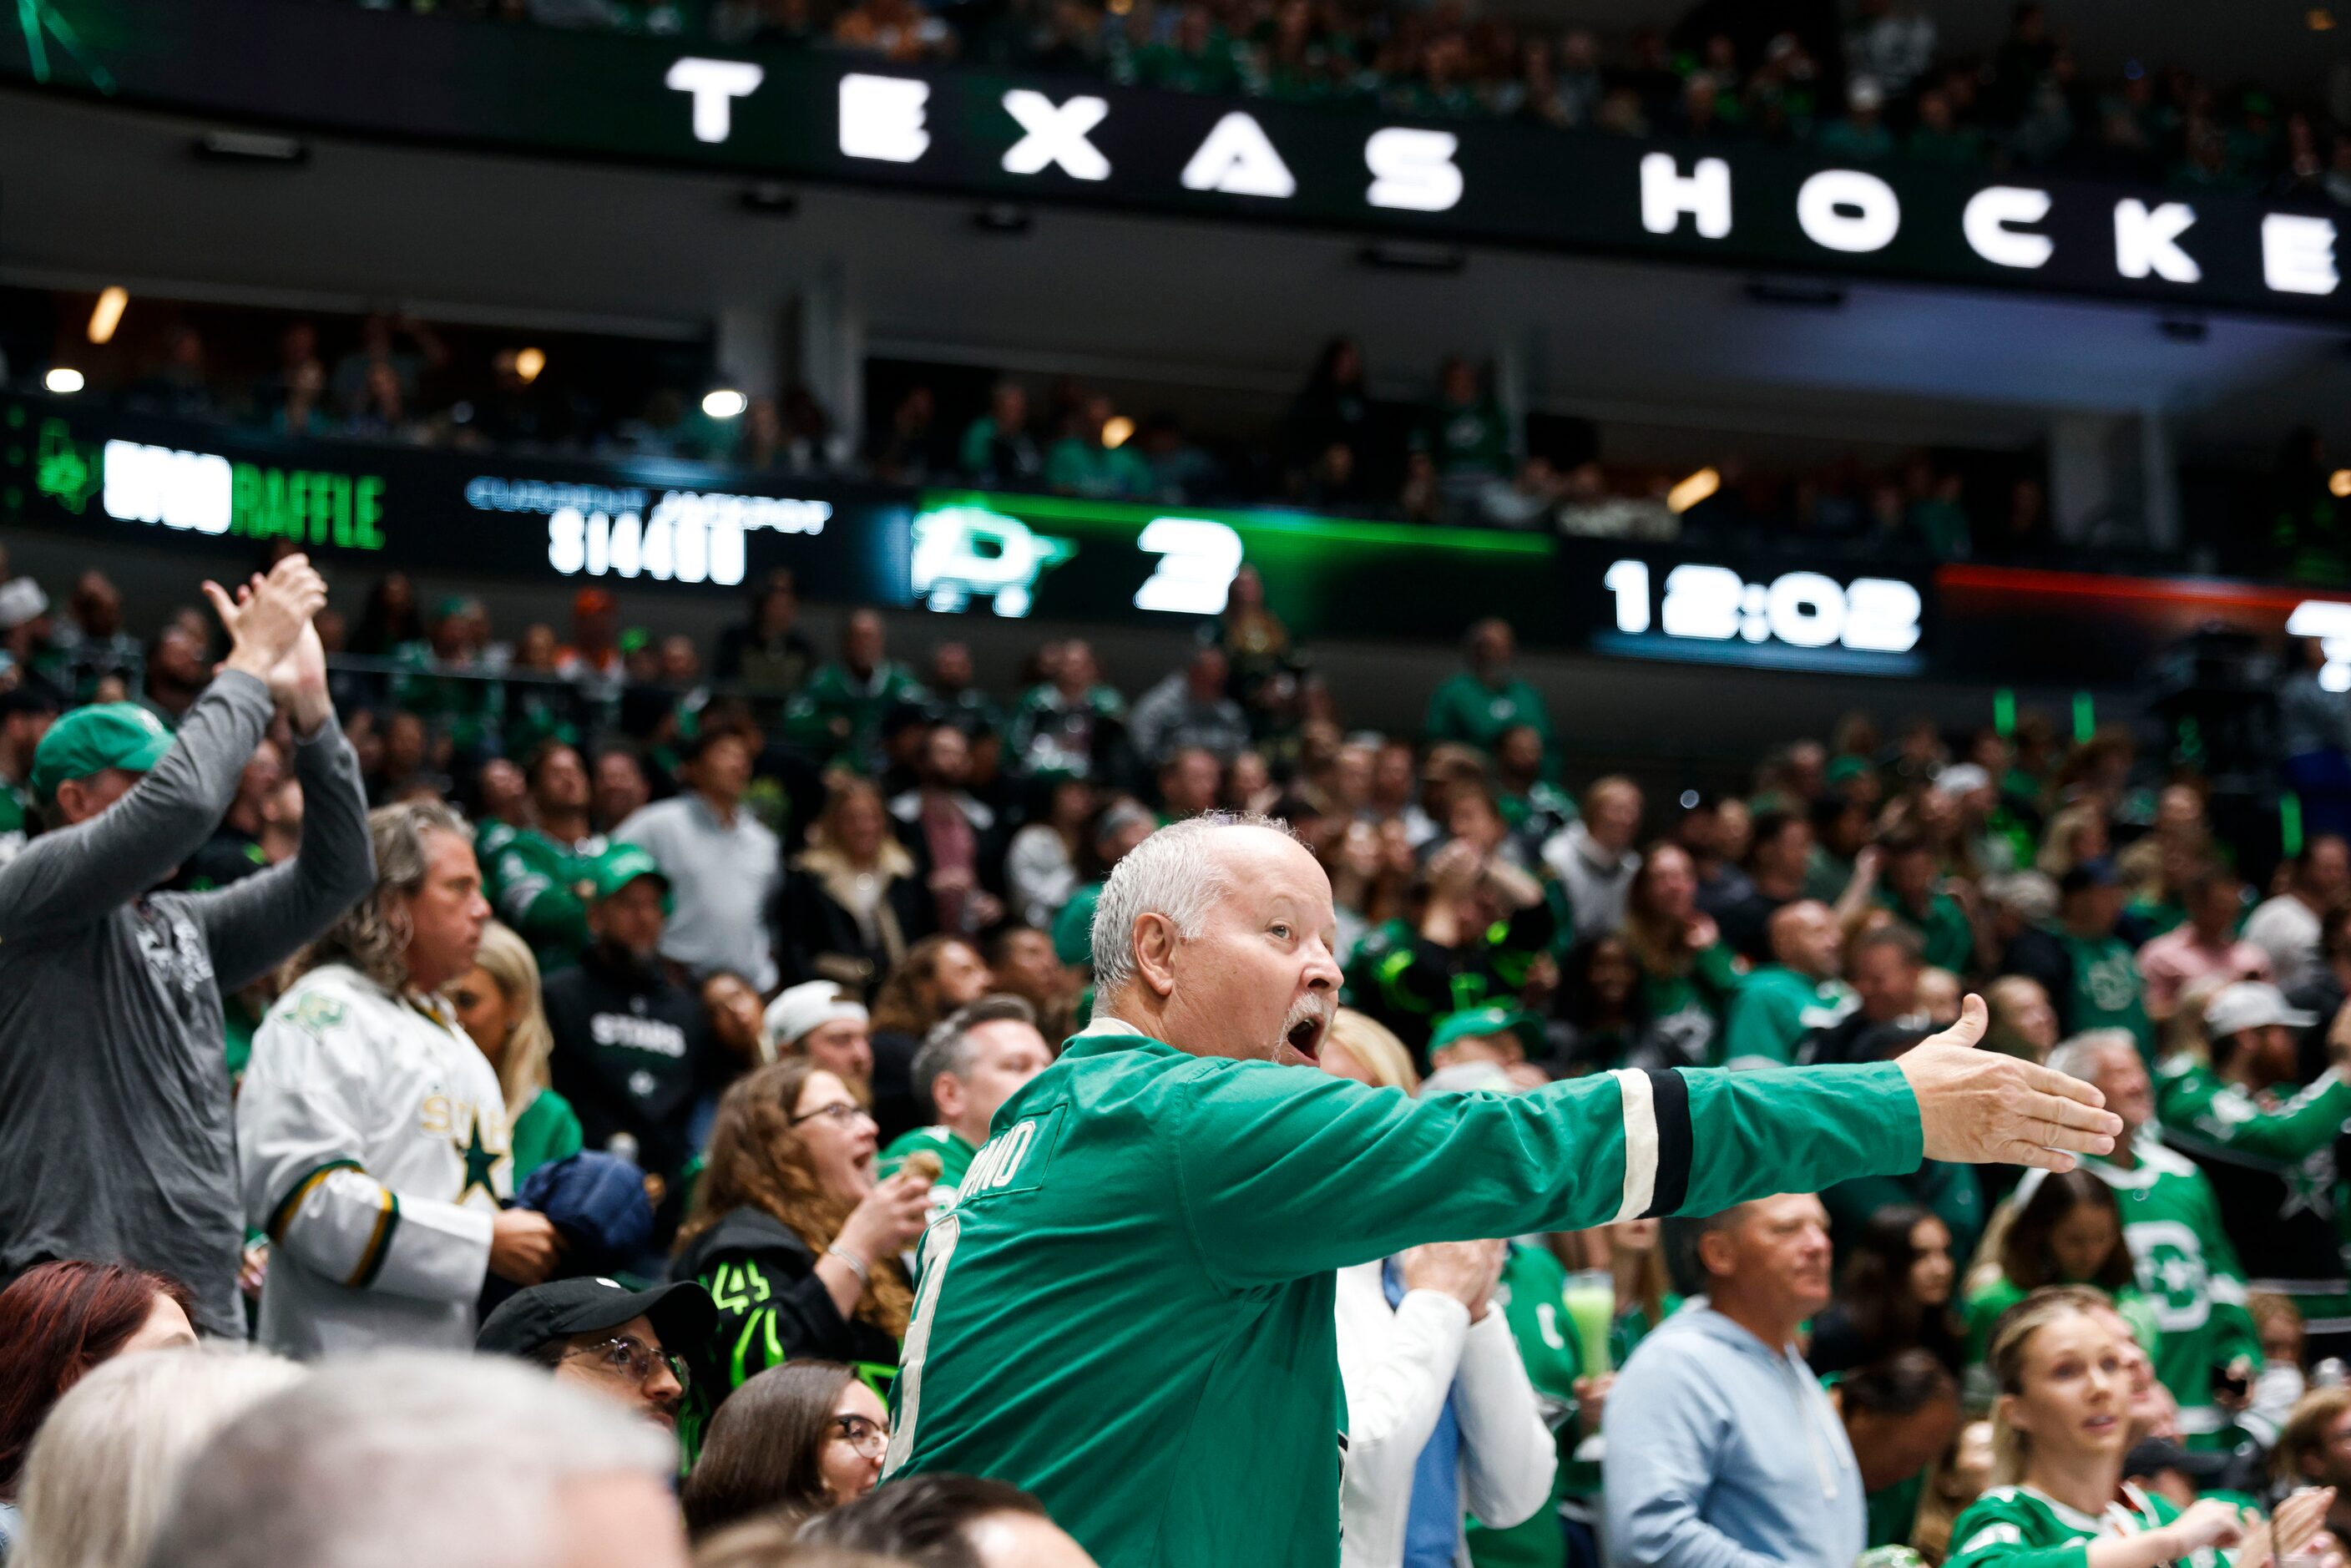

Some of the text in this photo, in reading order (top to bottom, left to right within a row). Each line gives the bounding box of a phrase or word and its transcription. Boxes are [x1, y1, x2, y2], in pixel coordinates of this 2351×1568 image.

[664, 56, 1464, 212] TEXAS
[231, 461, 386, 552] RAFFLE
[1133, 516, 1244, 615] 2
[1601, 558, 1922, 654] 12:02
[589, 1011, 686, 1058] STARS
